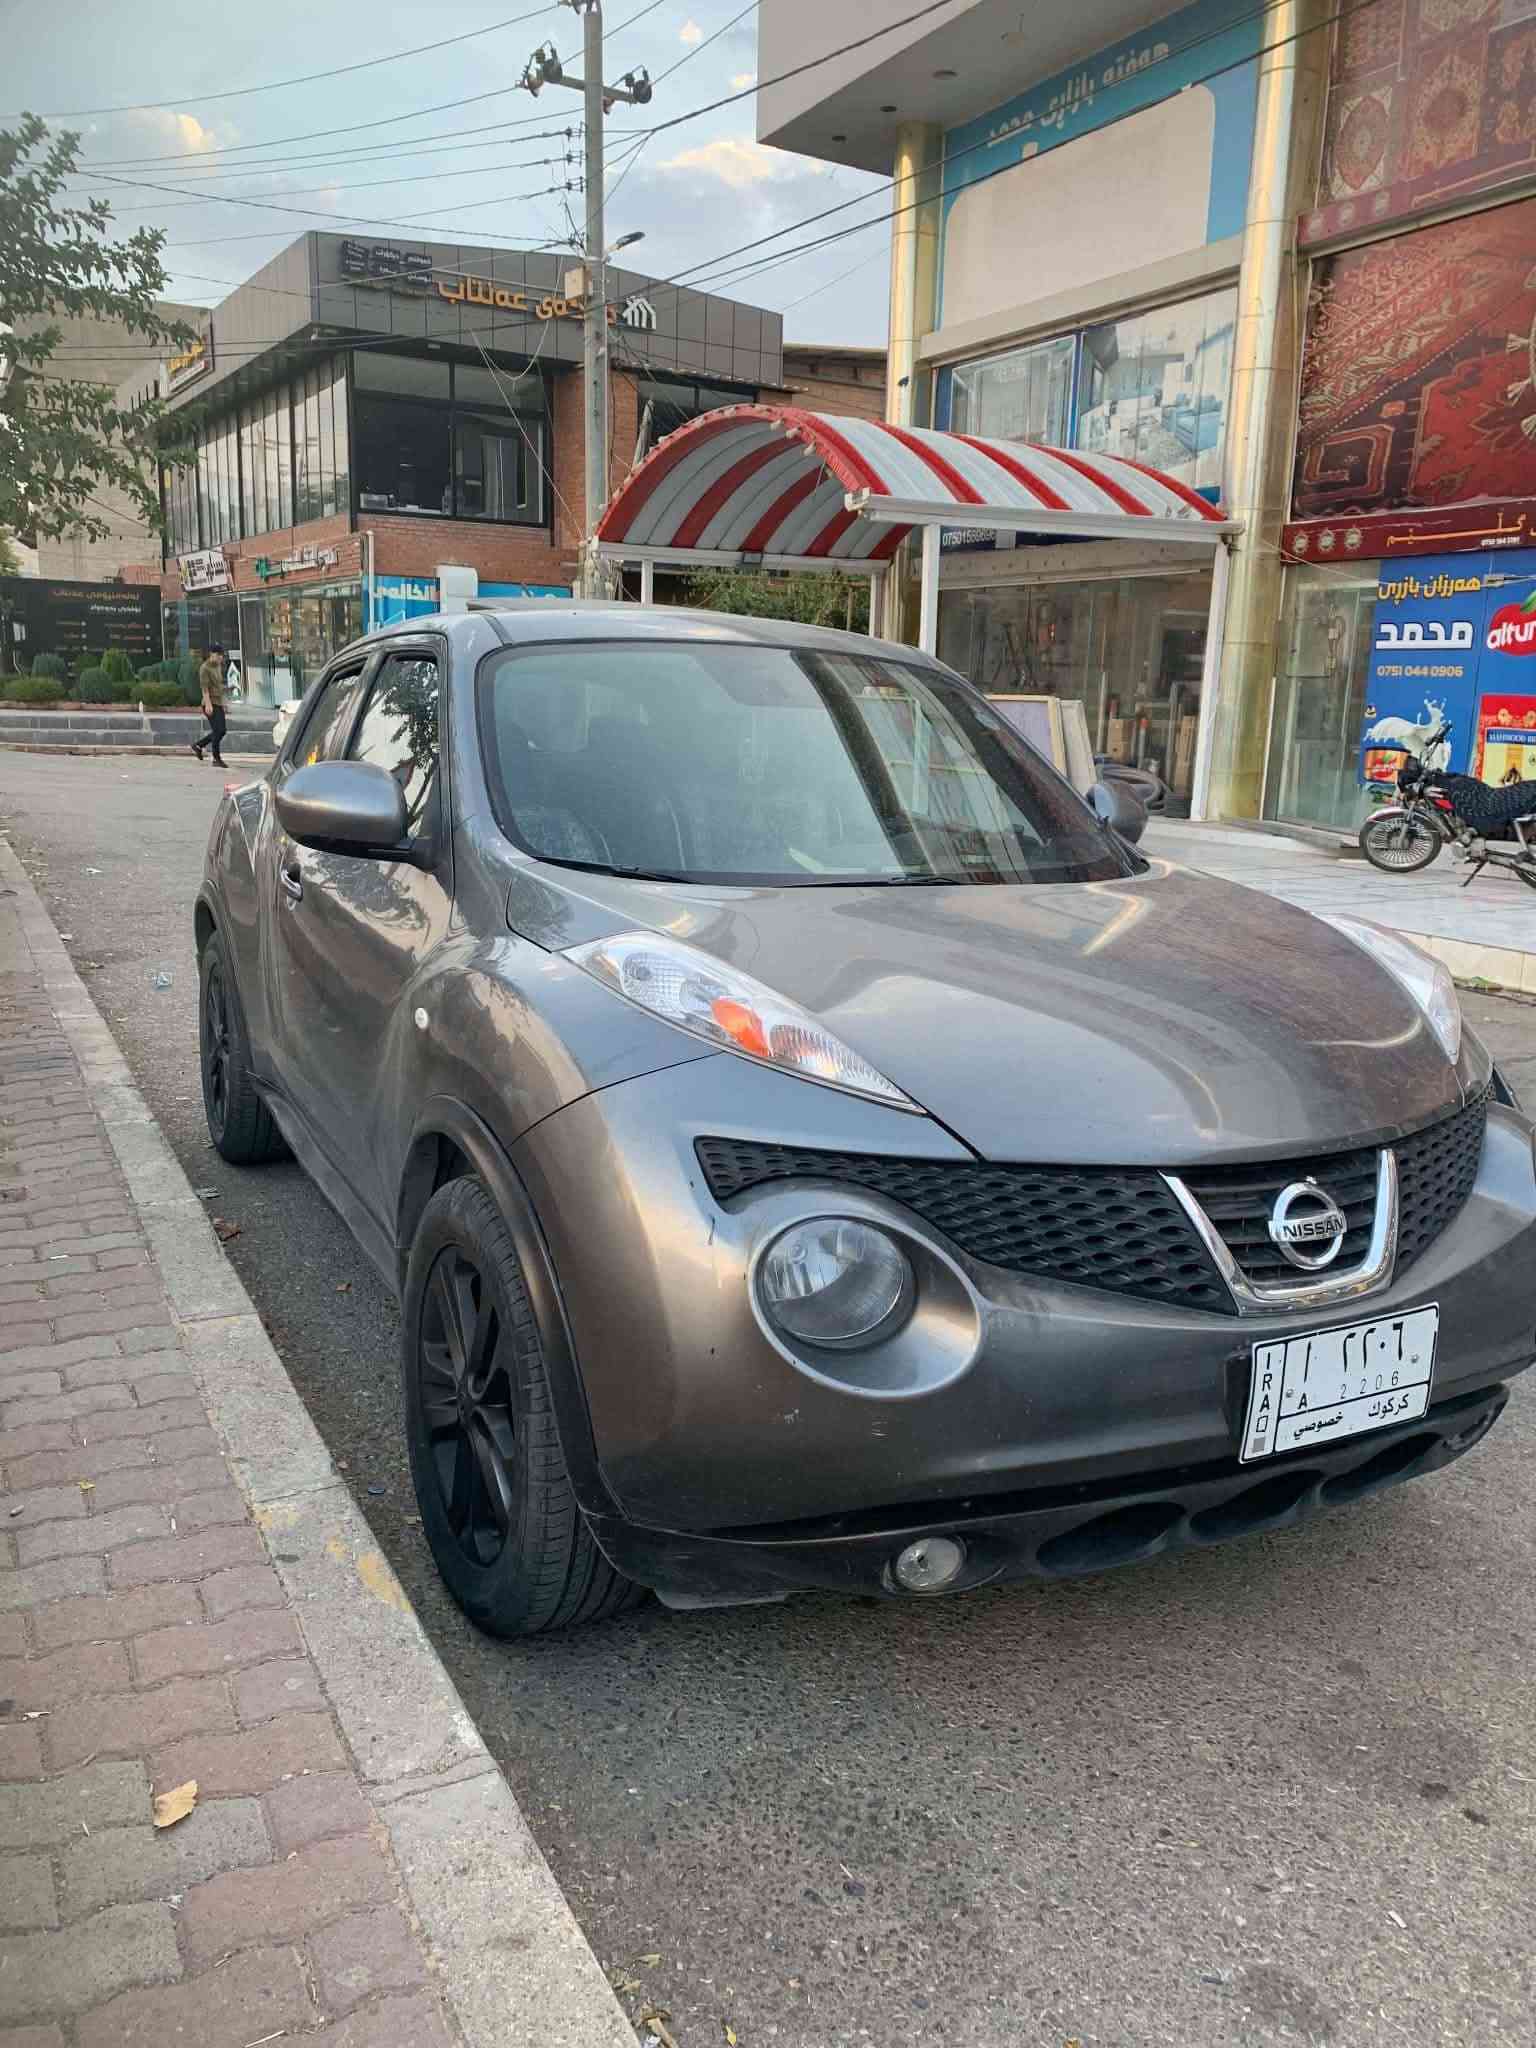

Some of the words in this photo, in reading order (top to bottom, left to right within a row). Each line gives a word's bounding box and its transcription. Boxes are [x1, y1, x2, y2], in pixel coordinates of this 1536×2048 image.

[1375, 621, 1473, 649] محمد
[1283, 1215, 1343, 1237] NISSAN
[1368, 1394, 1410, 1419] كركوك
[1293, 1411, 1344, 1440] خصوصي
